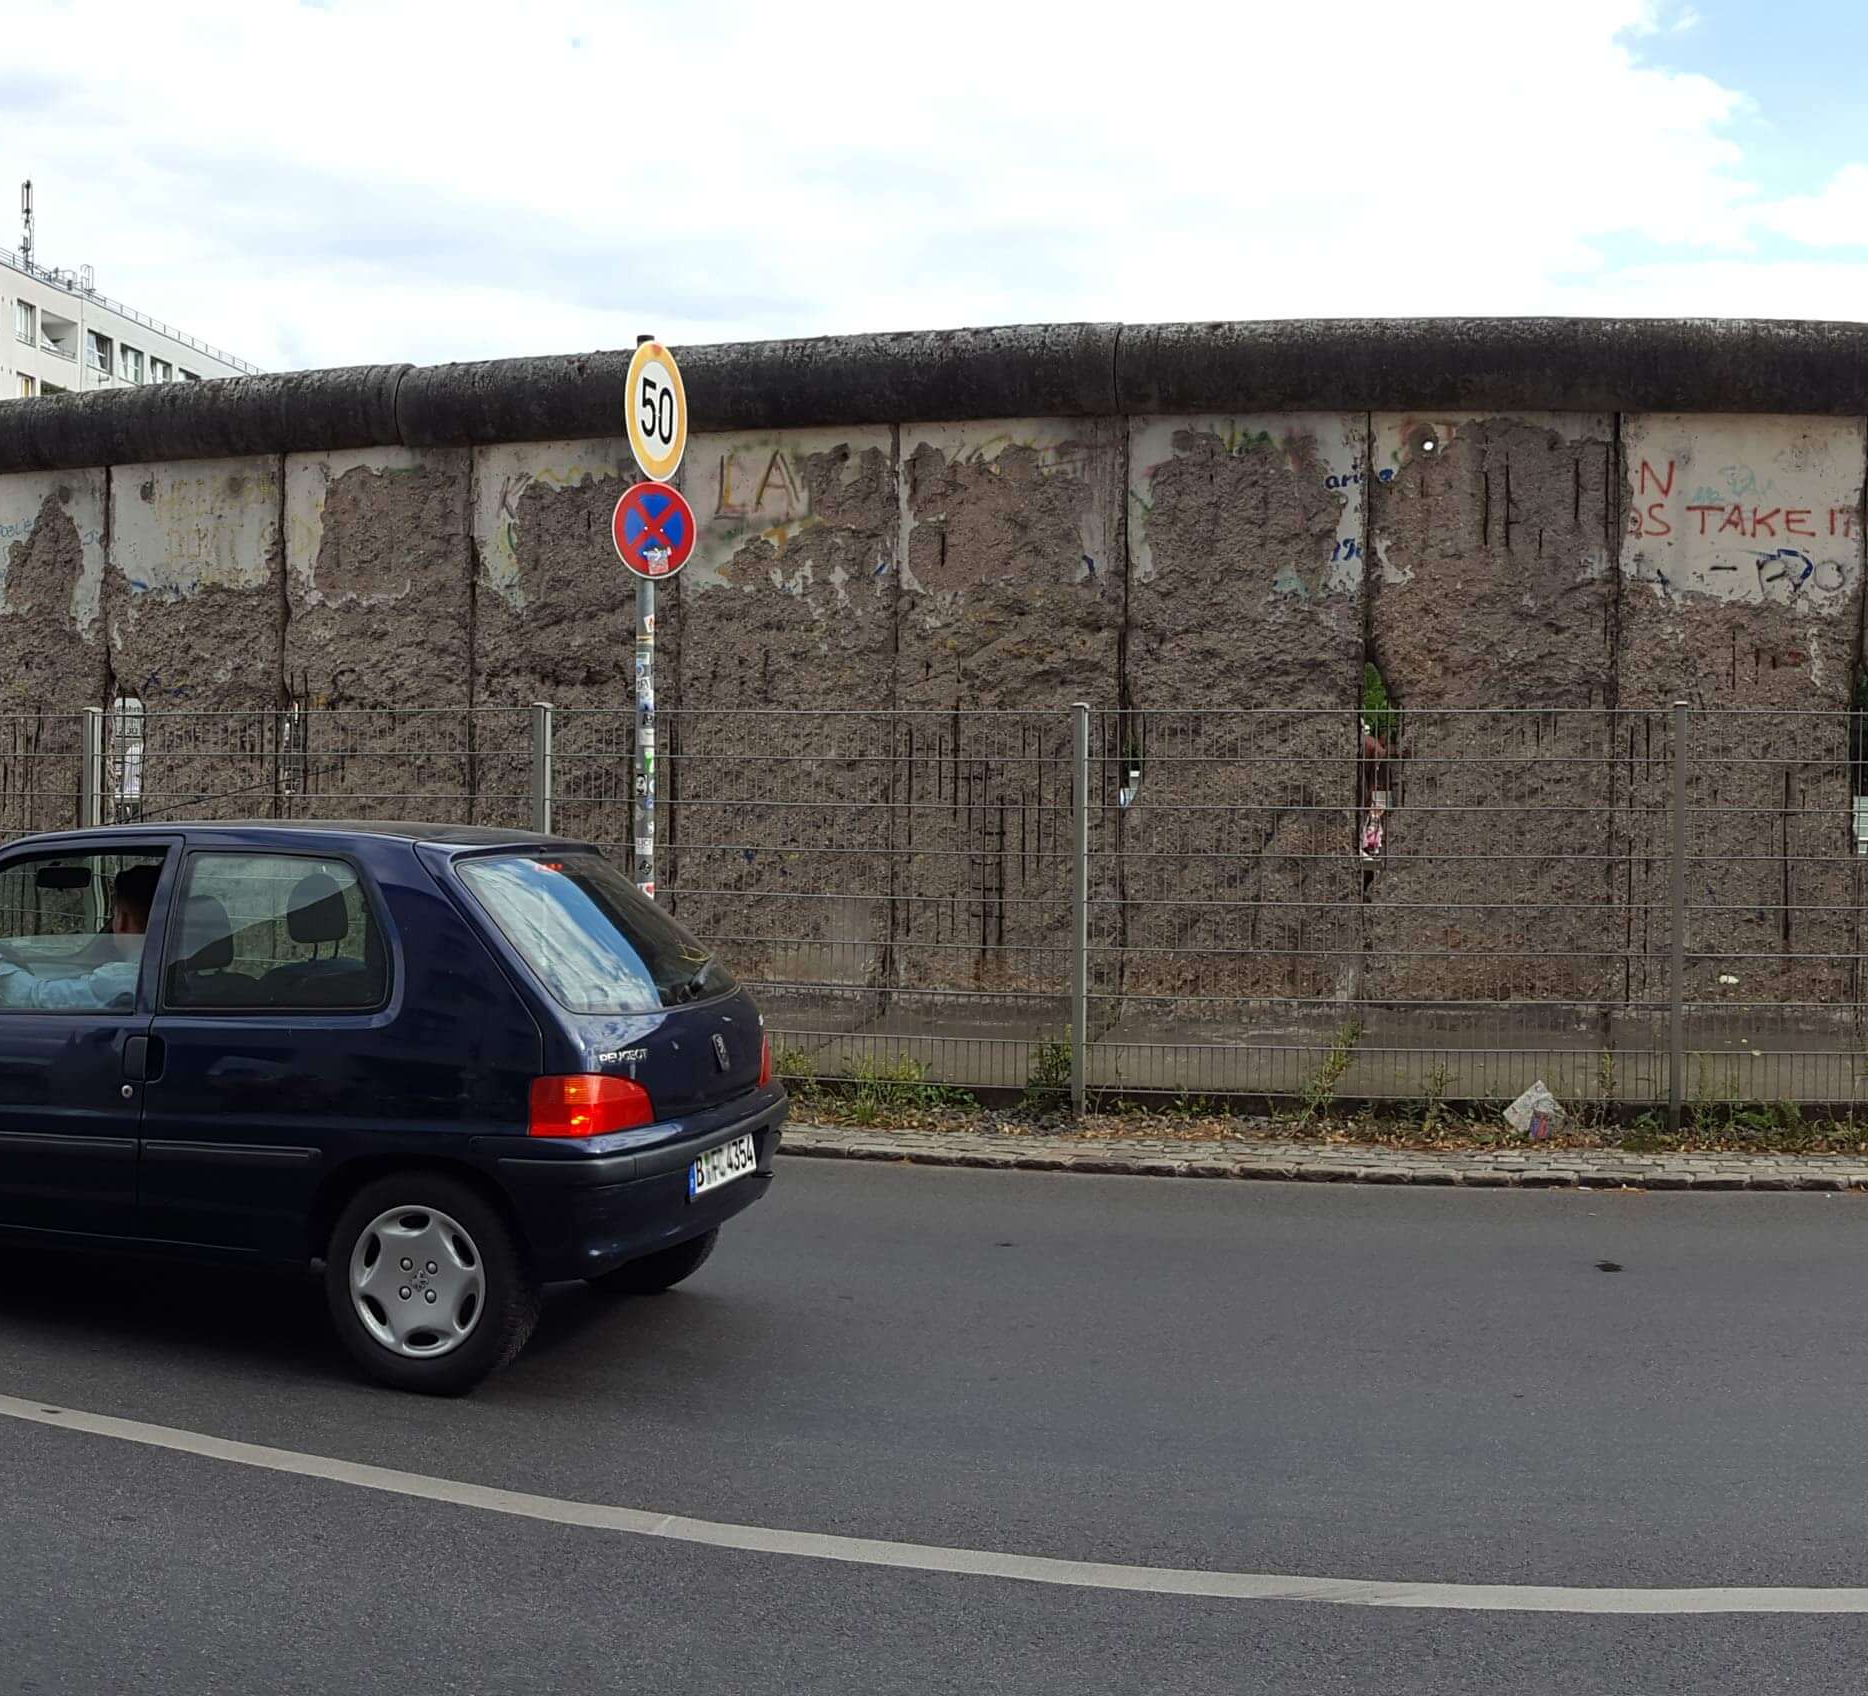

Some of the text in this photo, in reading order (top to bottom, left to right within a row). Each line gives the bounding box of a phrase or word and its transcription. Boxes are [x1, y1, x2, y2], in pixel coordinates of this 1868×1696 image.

[640, 378, 674, 446] 50
[1685, 503, 1817, 539] TAKE
[599, 1048, 649, 1063] PEUGEOT
[695, 1156, 705, 1188] B
[726, 1136, 755, 1171] 4354
